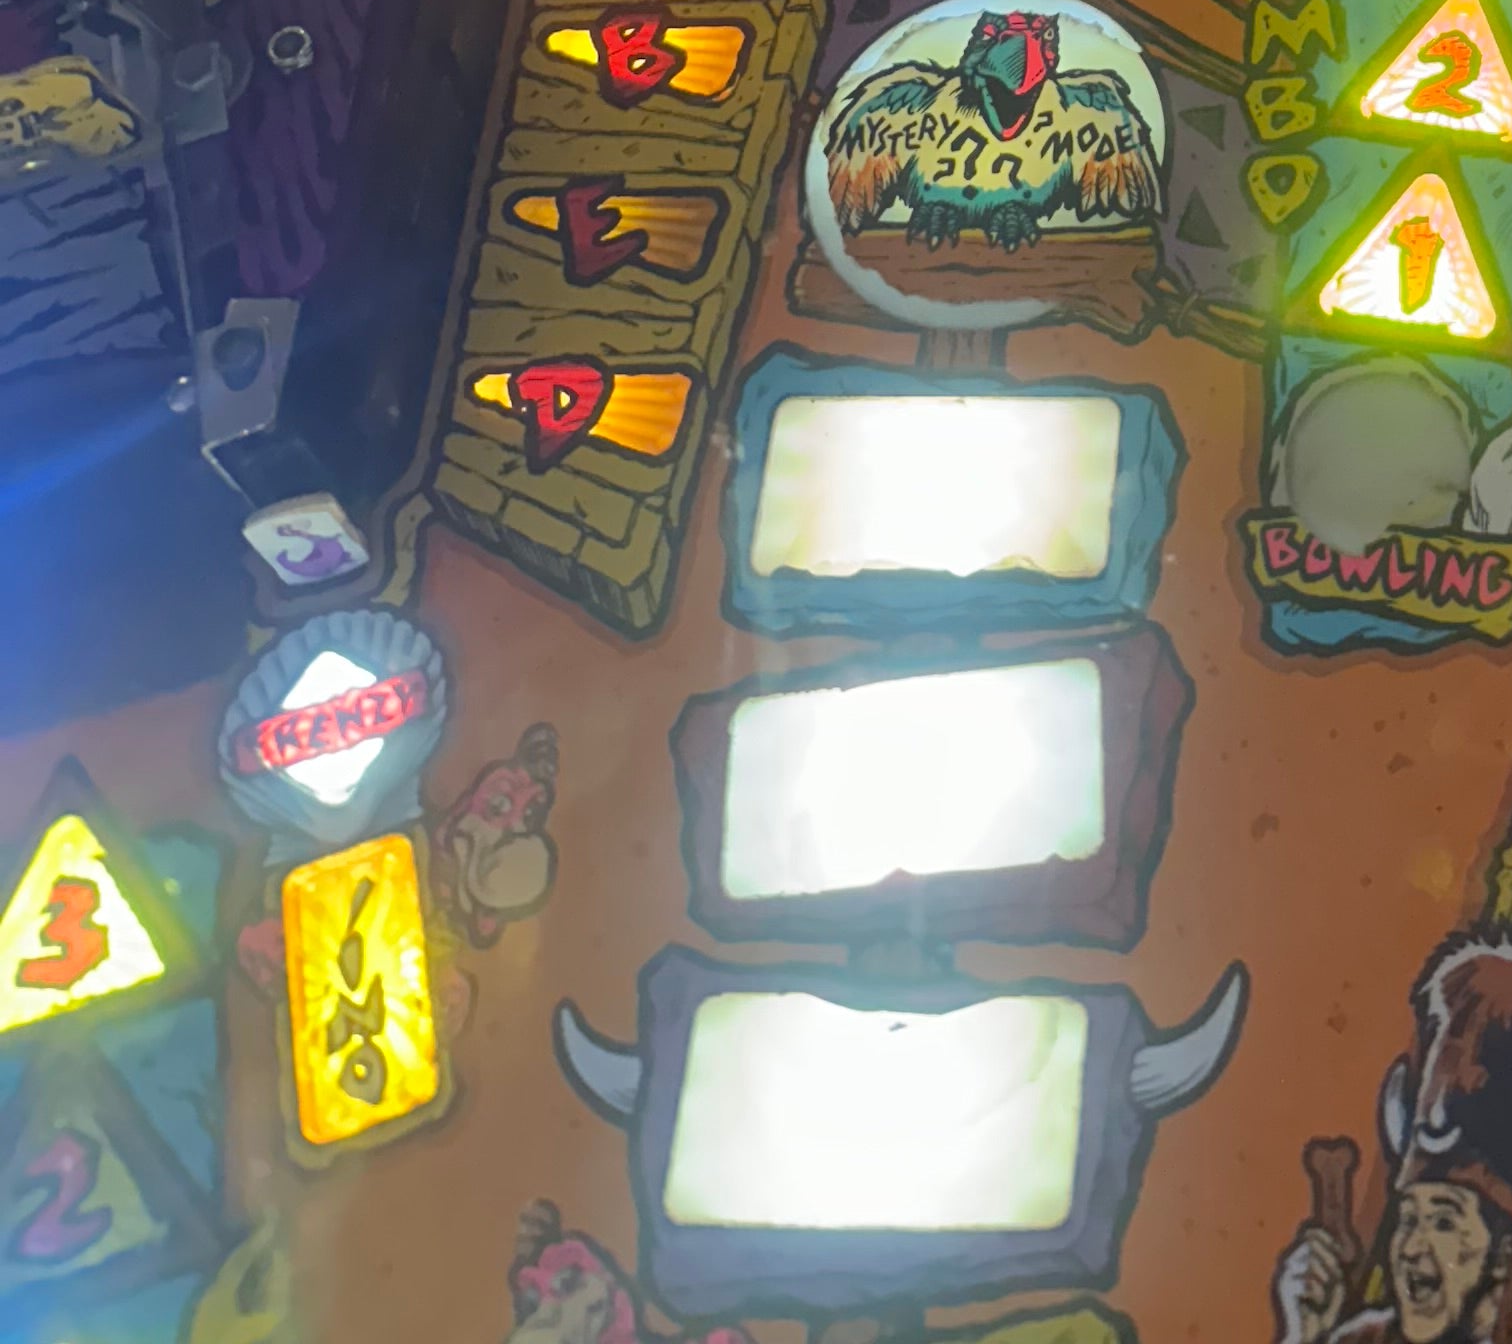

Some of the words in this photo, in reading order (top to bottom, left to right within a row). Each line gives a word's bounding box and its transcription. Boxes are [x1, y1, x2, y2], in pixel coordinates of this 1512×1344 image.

[1410, 30, 1484, 121] 2
[835, 110, 961, 159] MYSTERY
[1039, 122, 1143, 166] MODE
[258, 680, 415, 762] RENZY
[17, 877, 111, 992] 3
